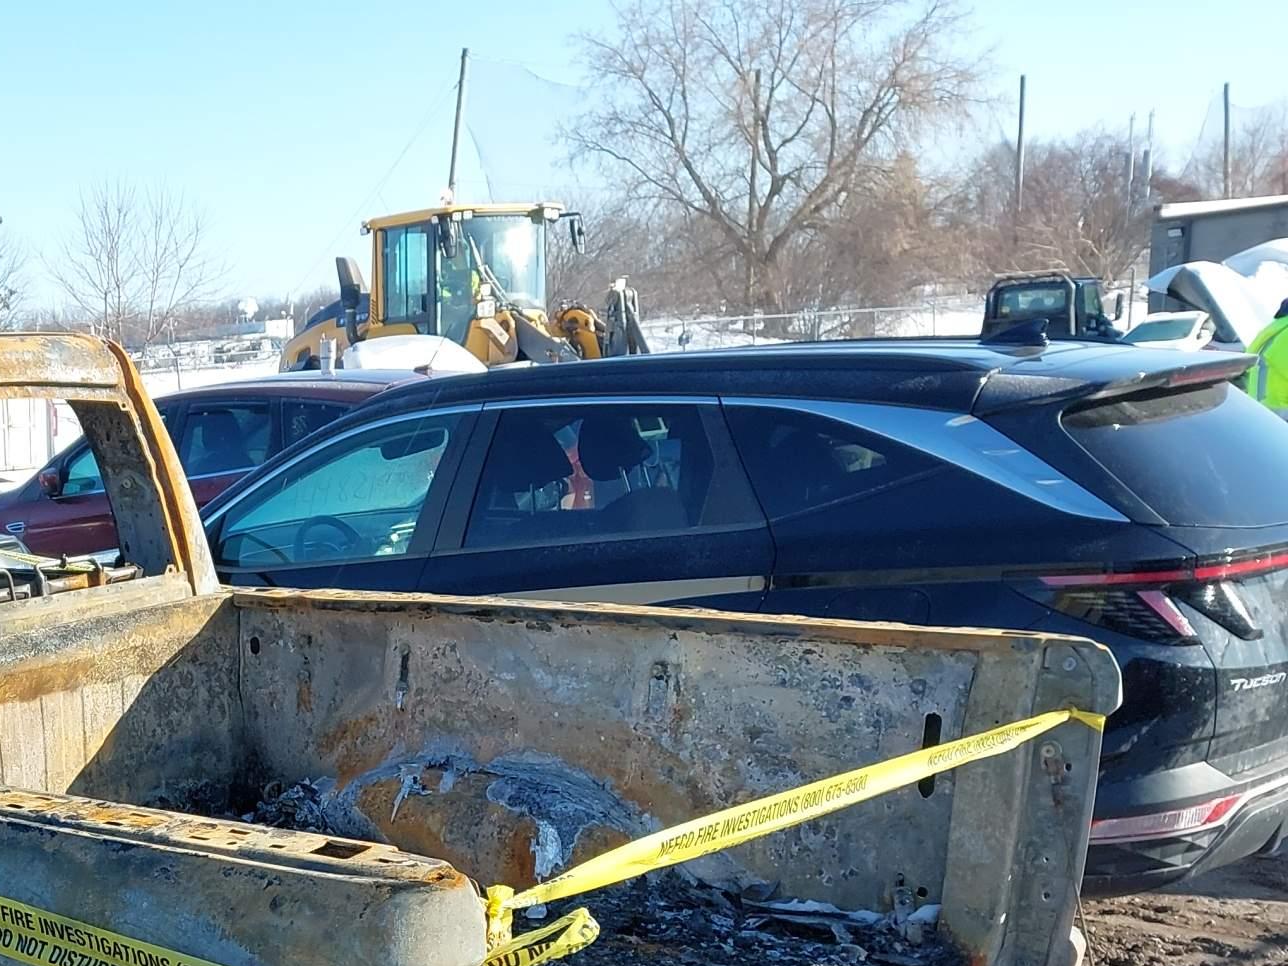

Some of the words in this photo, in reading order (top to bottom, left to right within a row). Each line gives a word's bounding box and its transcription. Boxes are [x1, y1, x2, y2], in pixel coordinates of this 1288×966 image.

[695, 824, 720, 847] FIRE
[721, 796, 800, 838] INVESTIGATIONS
[801, 789, 824, 813] (800)
[826, 774, 868, 803] 675-8500
[0, 905, 37, 931] FIRE
[15, 933, 48, 960] NOT
